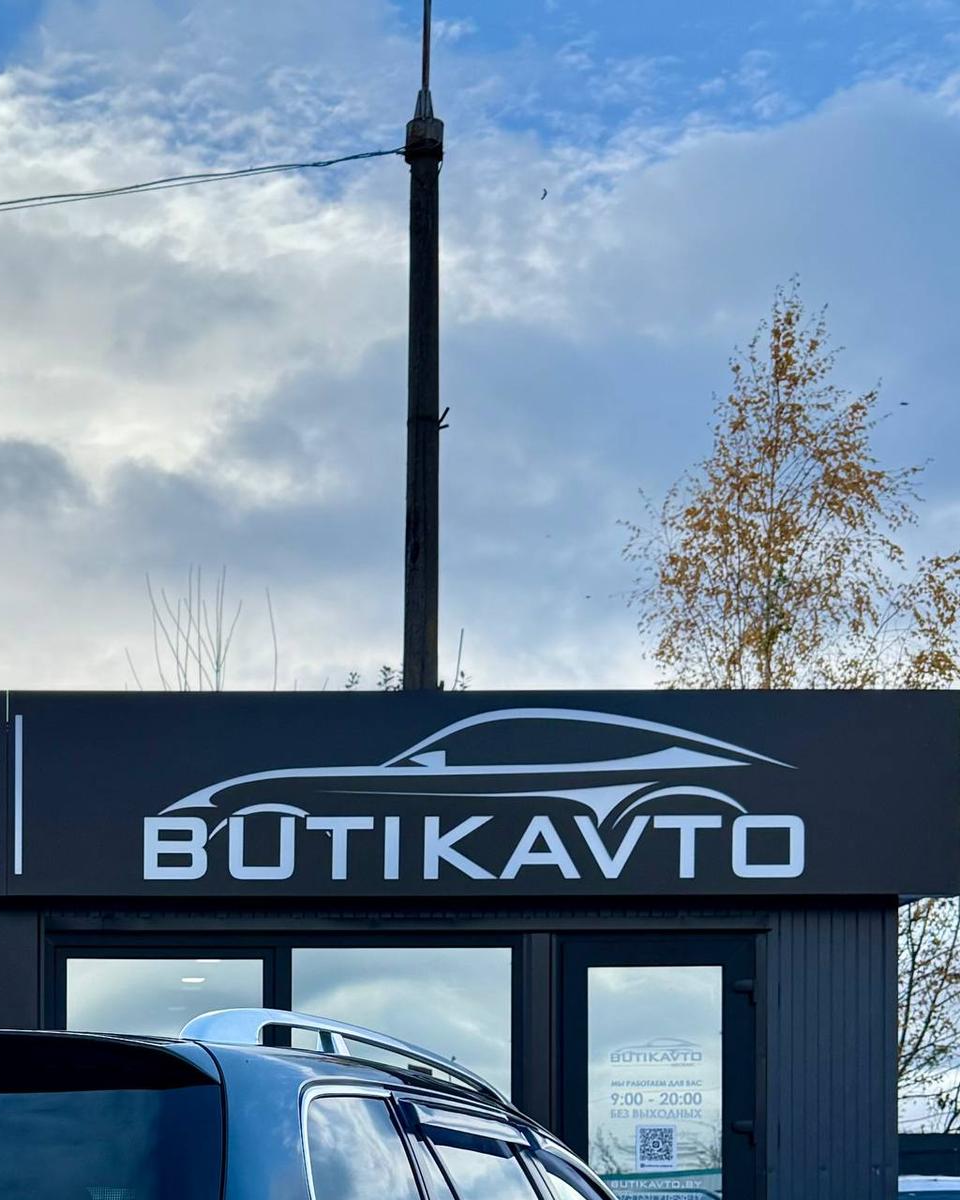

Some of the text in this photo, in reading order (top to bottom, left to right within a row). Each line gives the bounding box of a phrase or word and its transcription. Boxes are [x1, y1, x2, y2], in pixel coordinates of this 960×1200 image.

[143, 813, 805, 881] BUTIKAVTO
[610, 1051, 702, 1062] BUTIKAVTO
[610, 1092, 643, 1106] 9:00
[660, 1092, 702, 1106] 20:00
[610, 1109, 702, 1120] БЕЗ ВЫХОДНЫХ
[610, 1180, 703, 1189] BUTIKAVTO.BY
